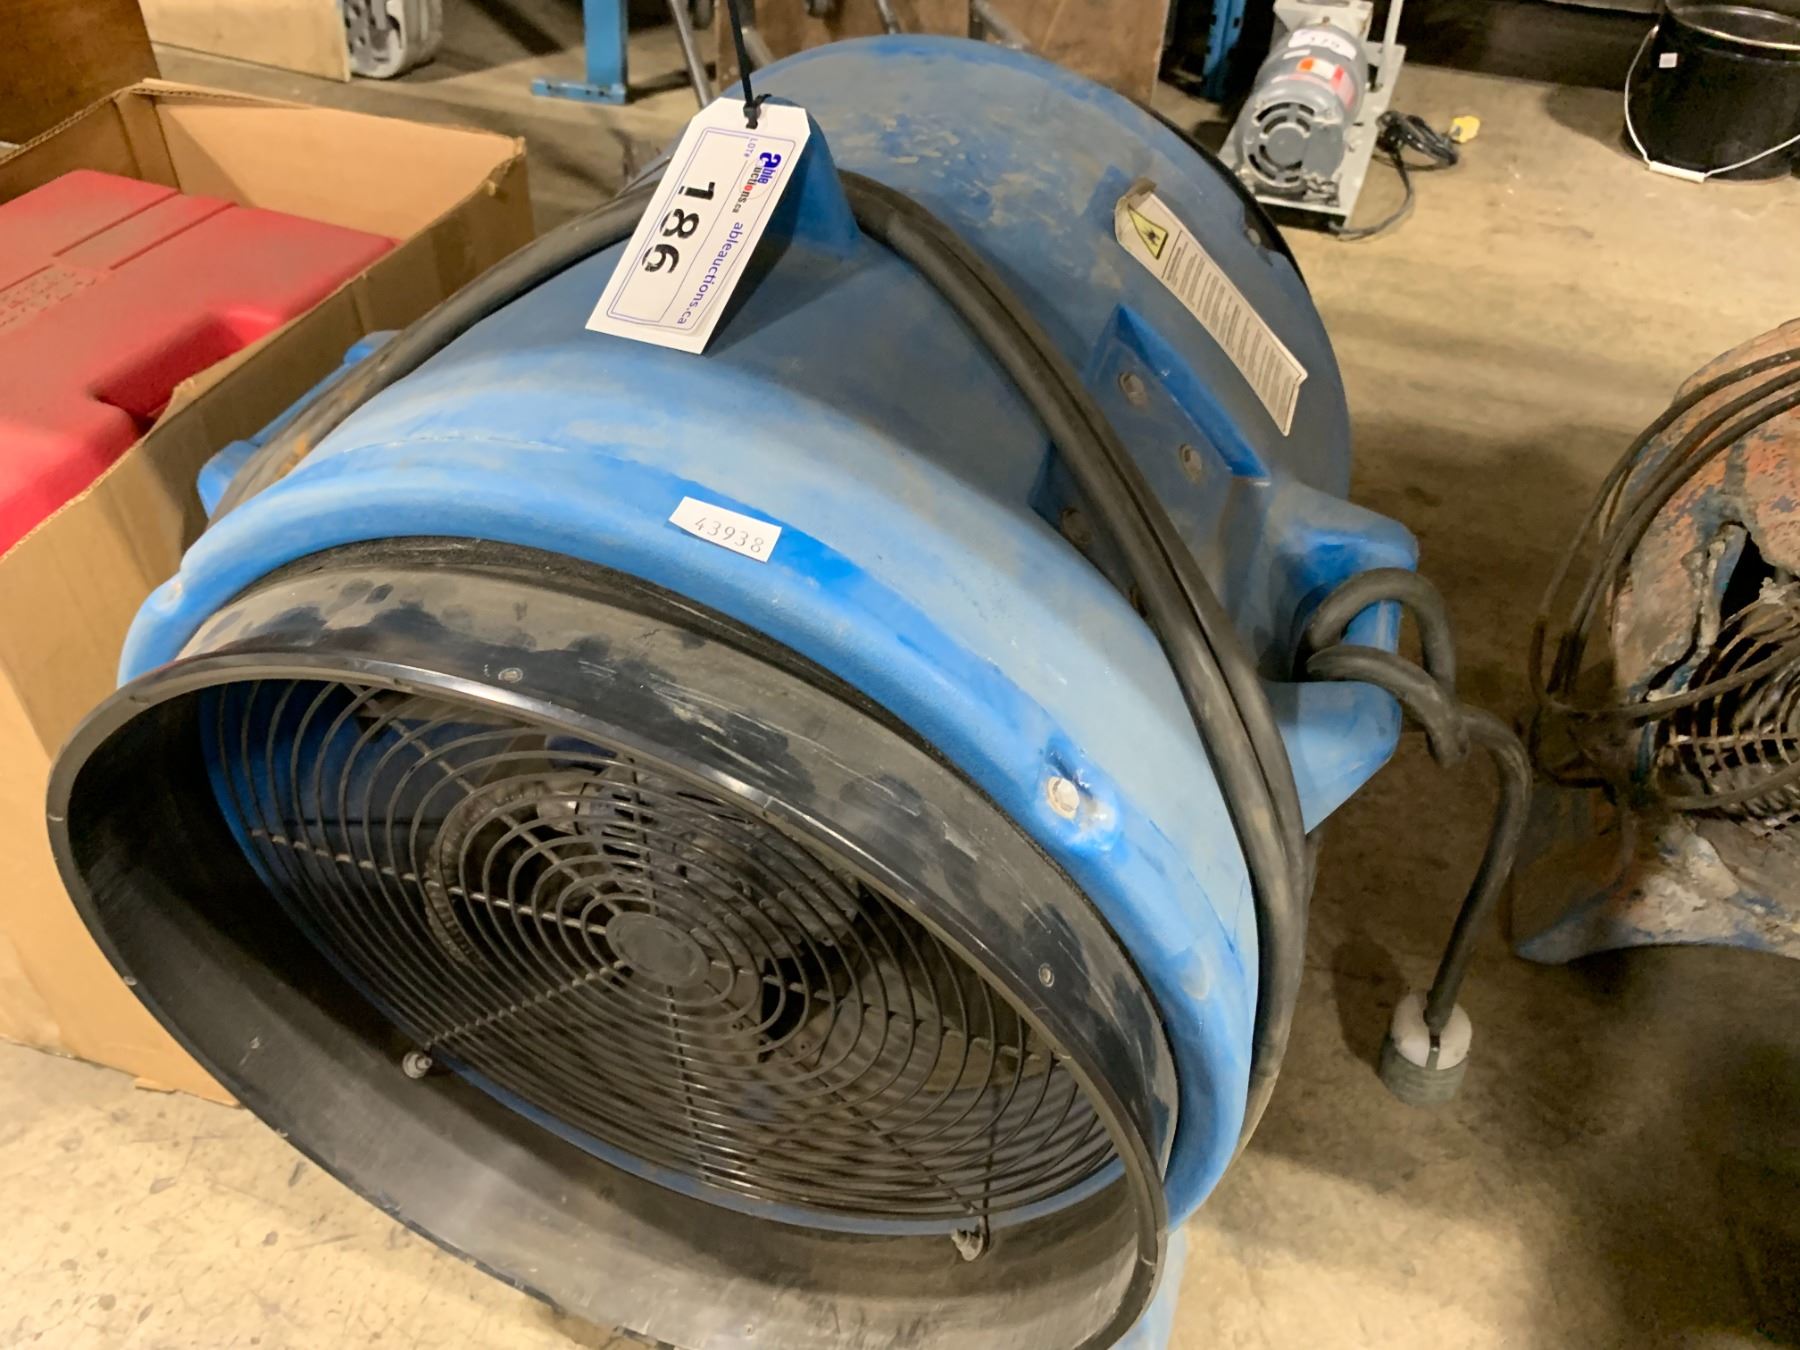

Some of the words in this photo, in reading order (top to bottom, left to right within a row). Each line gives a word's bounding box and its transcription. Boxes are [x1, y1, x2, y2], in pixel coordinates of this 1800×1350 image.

[641, 181, 716, 274] 186
[676, 222, 744, 325] ableauctions.ca
[694, 517, 765, 553] 43938
